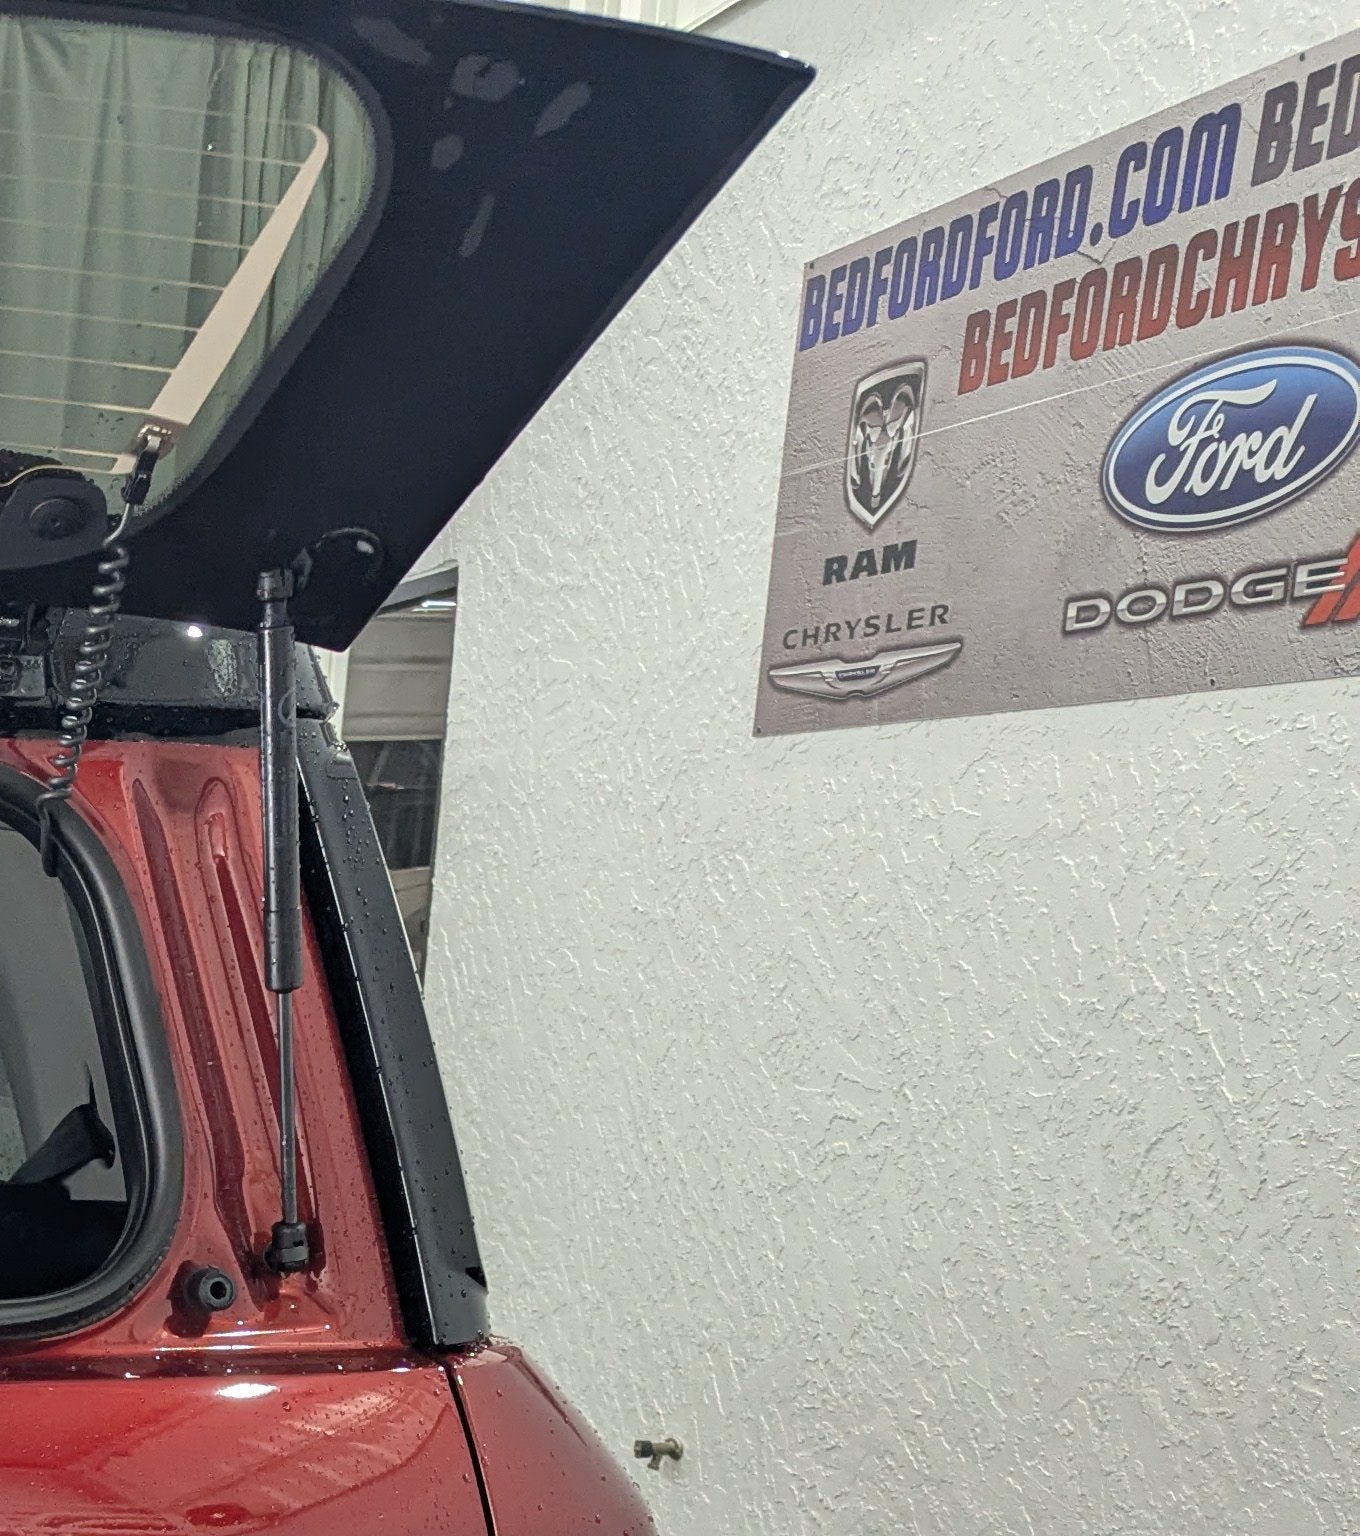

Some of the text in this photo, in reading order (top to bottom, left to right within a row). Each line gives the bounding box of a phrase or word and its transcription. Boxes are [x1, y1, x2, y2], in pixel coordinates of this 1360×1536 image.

[799, 102, 1242, 352] BEDFORDFORD.COM
[1145, 379, 1318, 505] Ford
[822, 539, 918, 586] RAM
[1064, 557, 1348, 632] DODGE
[782, 604, 950, 650] CHRYSLER
